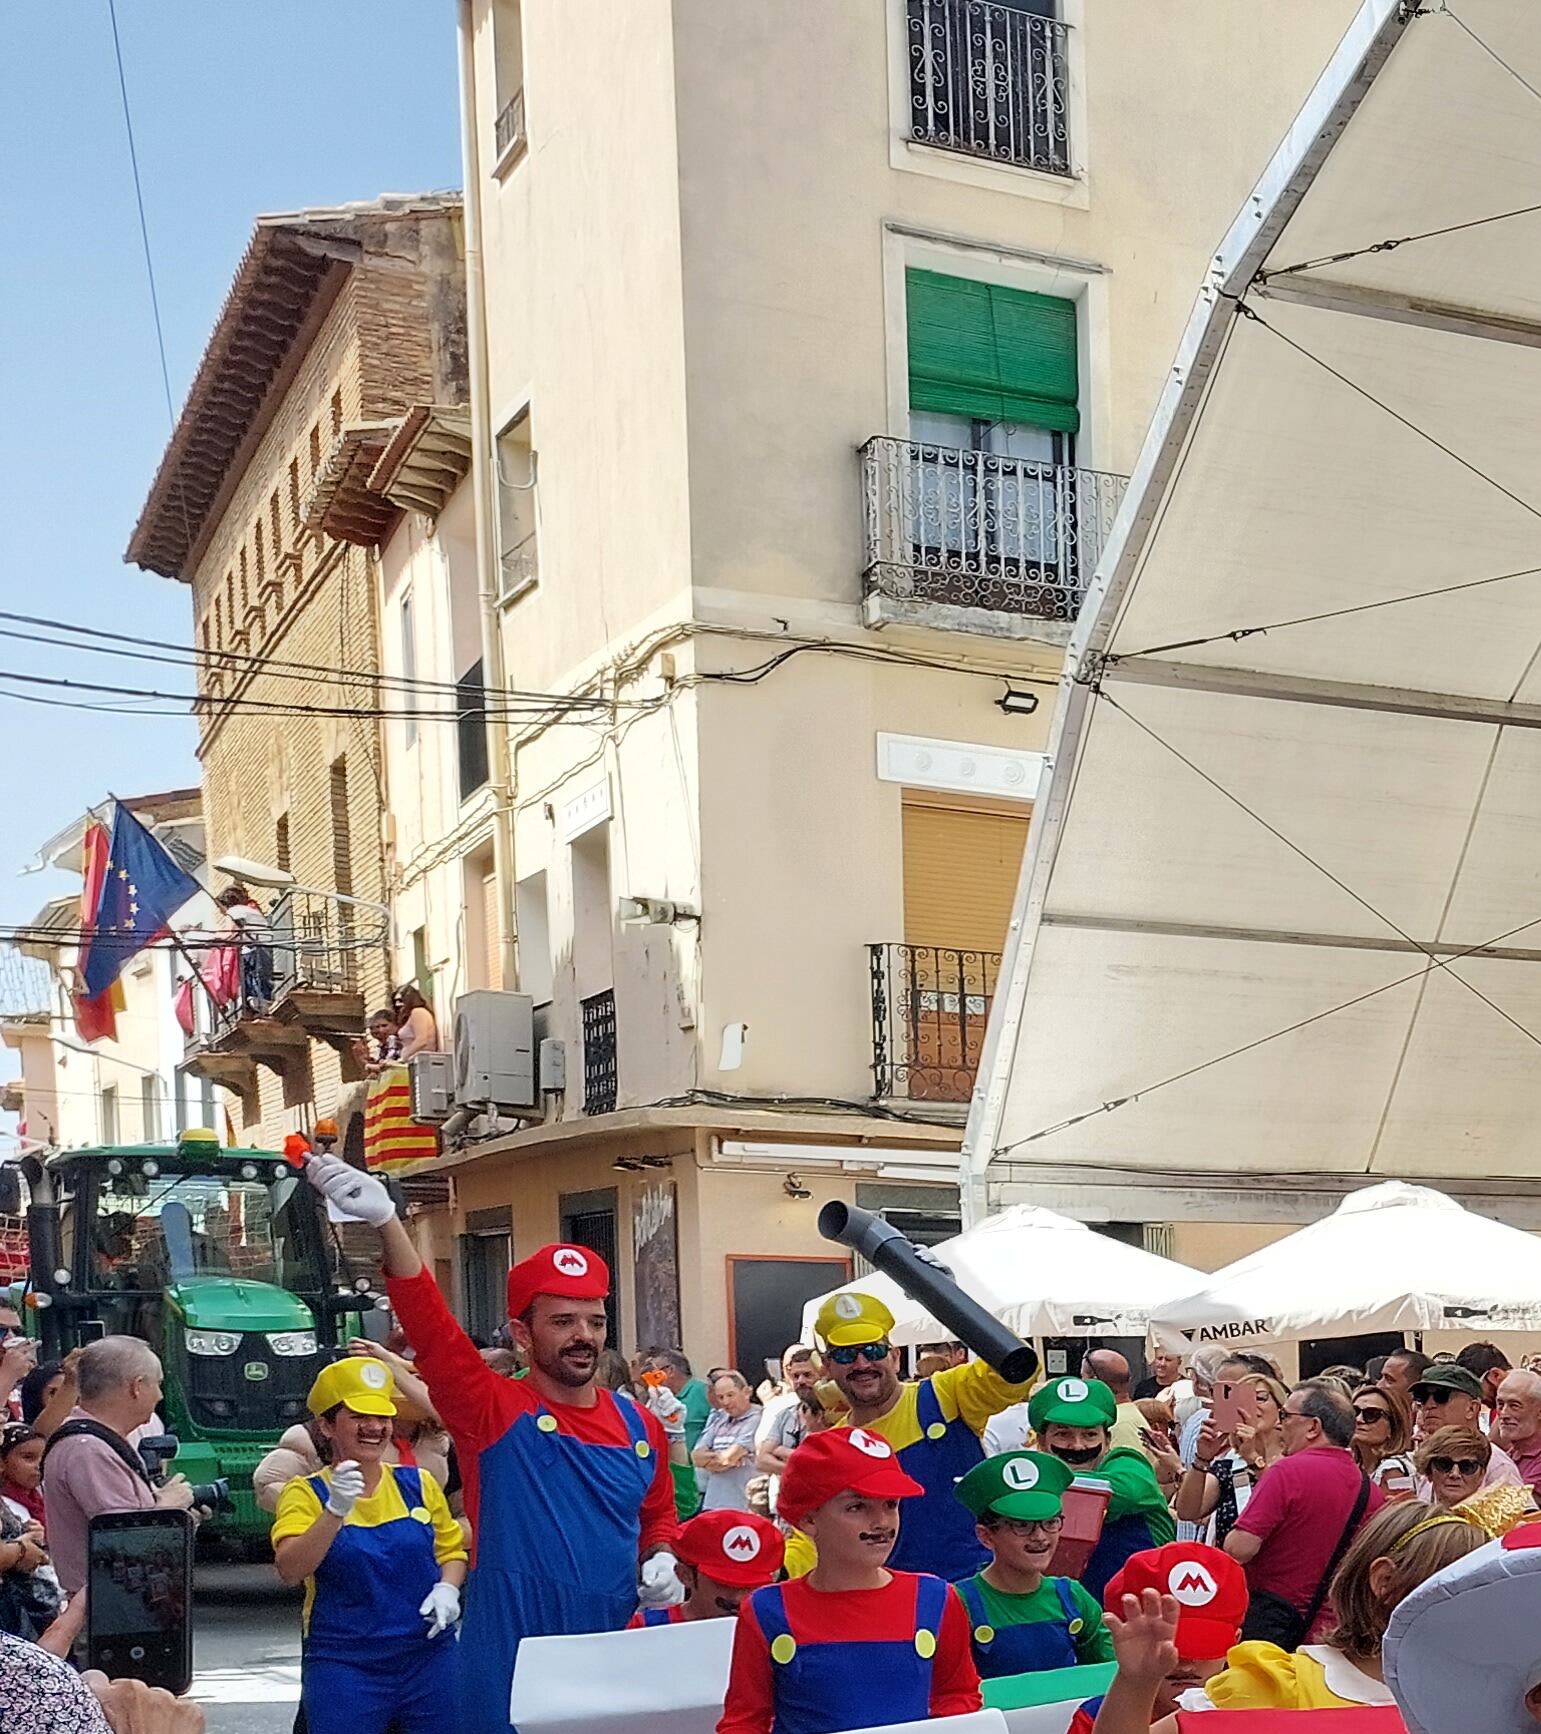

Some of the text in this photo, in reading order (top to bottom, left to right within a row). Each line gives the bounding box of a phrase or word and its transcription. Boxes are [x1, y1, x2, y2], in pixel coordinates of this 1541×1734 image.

[1200, 1319, 1270, 1342] AMBAR
[1065, 1383, 1081, 1398] L
[1010, 1465, 1033, 1485] L
[728, 1534, 754, 1552] M
[1176, 1571, 1212, 1594] M
